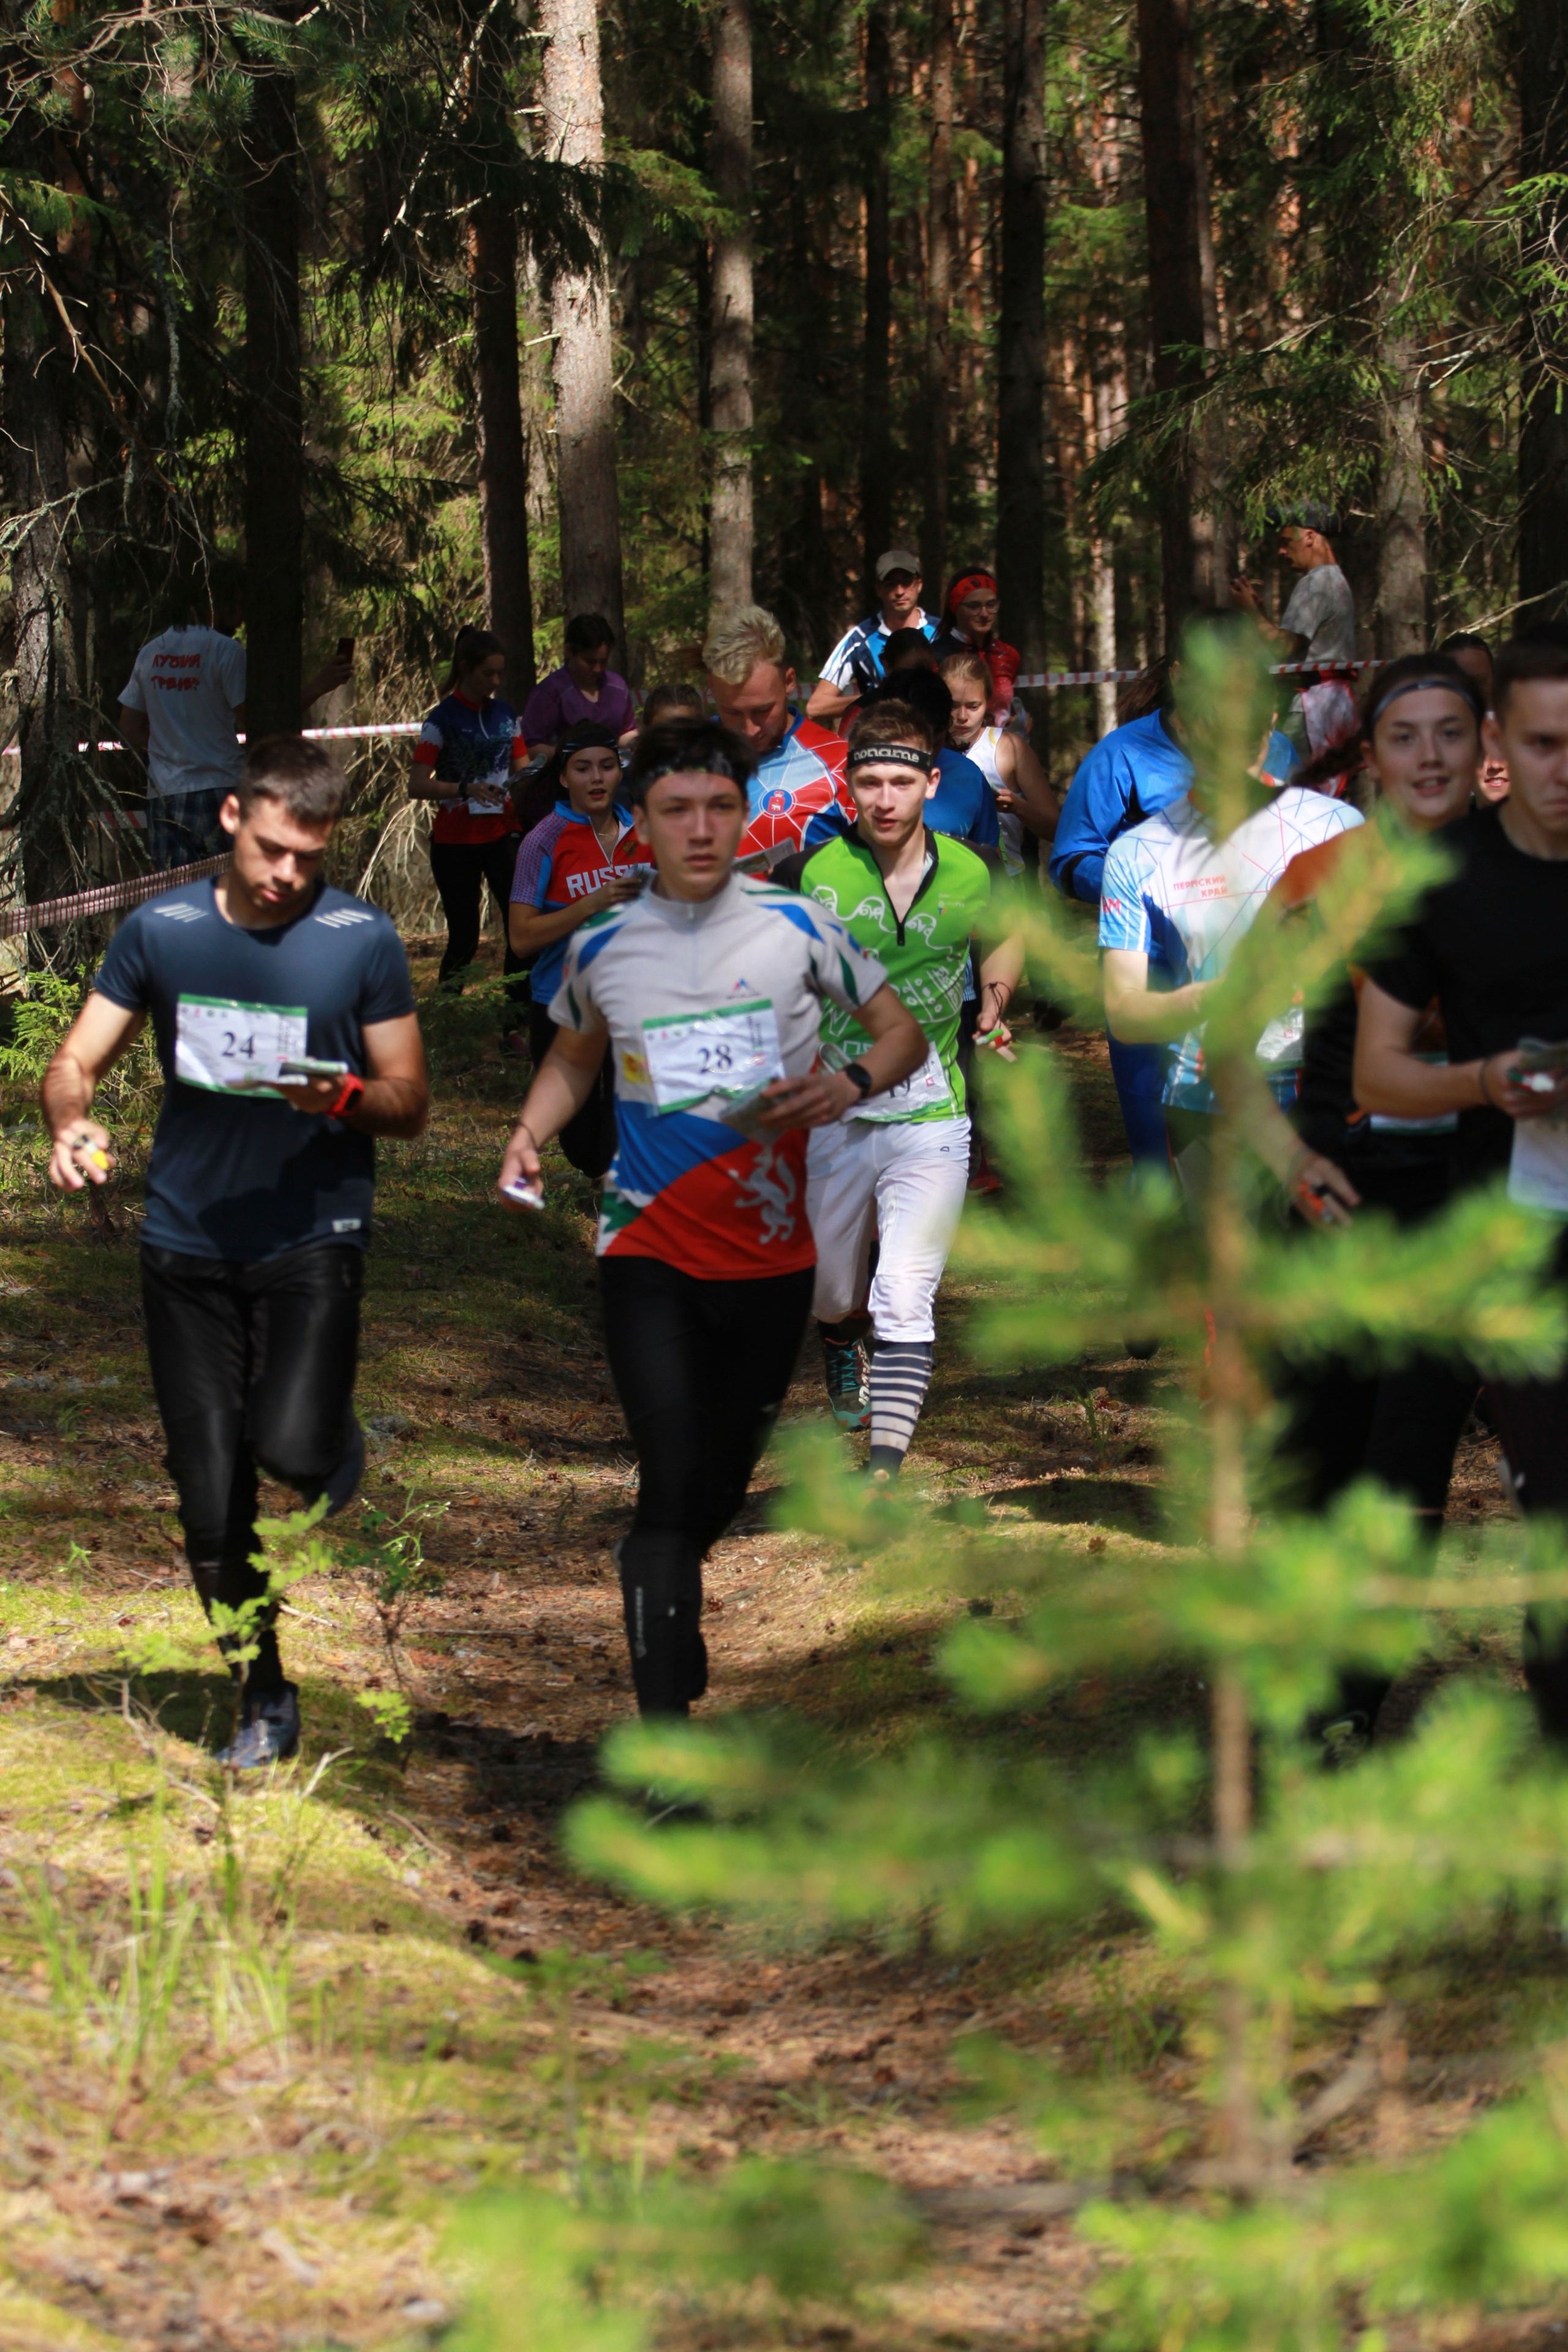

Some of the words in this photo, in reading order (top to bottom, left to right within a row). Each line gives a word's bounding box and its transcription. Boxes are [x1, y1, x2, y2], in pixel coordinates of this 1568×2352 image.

[854, 747, 919, 763] noname
[565, 862, 651, 899] RUS
[1173, 874, 1226, 891] ПЕРМСКИЙ
[1200, 886, 1228, 898] КРАЙ
[221, 1031, 255, 1059] 24
[698, 1044, 733, 1074] 28
